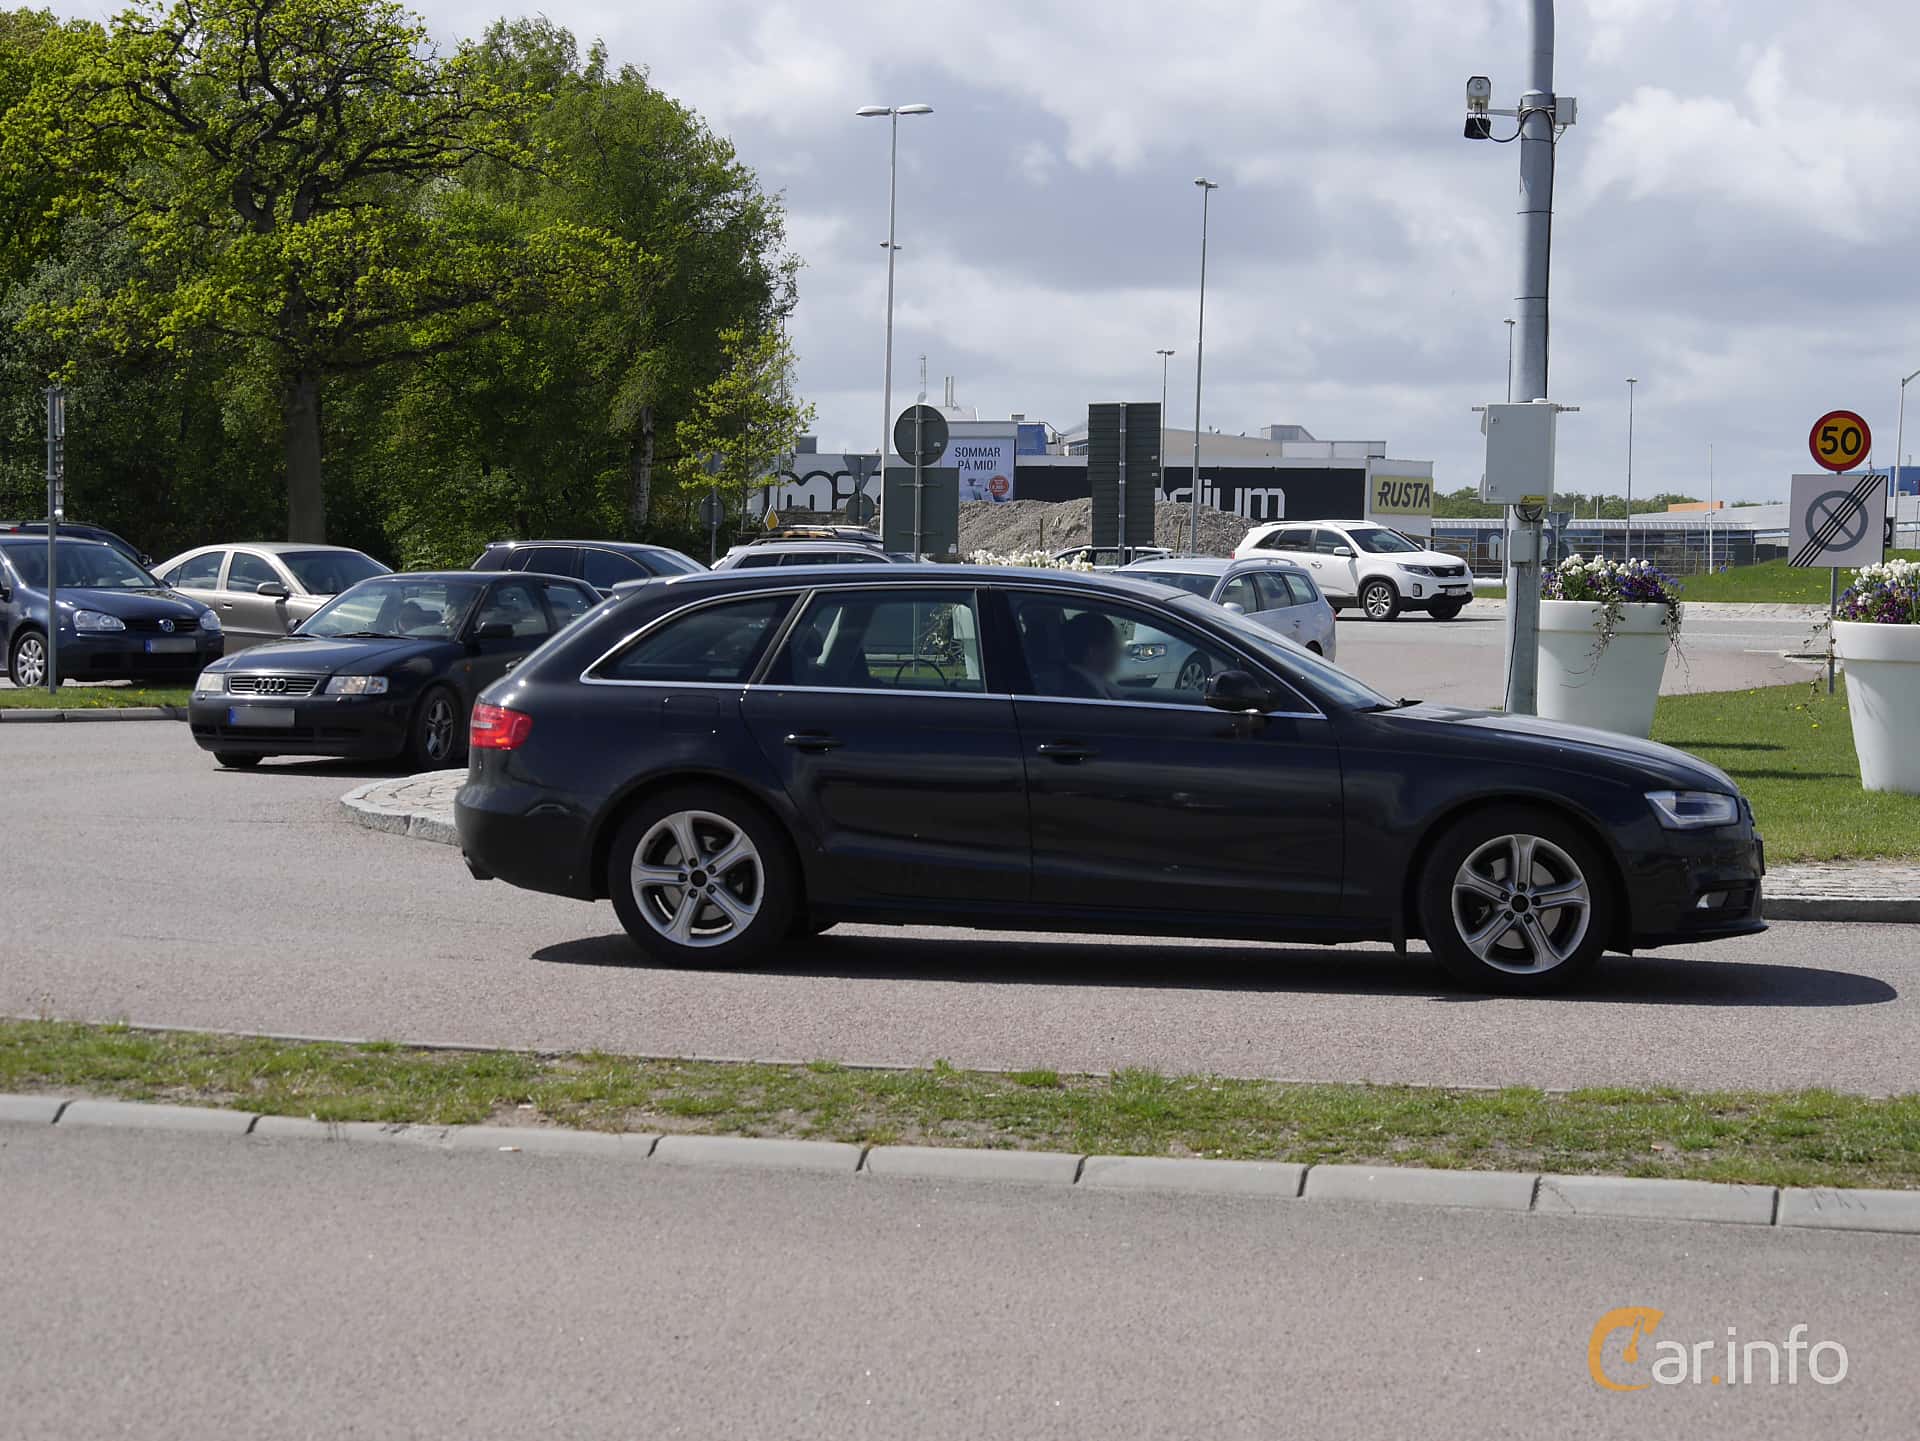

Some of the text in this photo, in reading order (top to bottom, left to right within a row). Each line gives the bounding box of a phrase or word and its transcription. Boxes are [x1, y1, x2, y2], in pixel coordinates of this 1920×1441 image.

[1820, 426, 1862, 456] 50
[954, 446, 1001, 458] SOMMAR
[958, 458, 997, 471] PÅ MIO!
[1377, 481, 1431, 508] RUSTA
